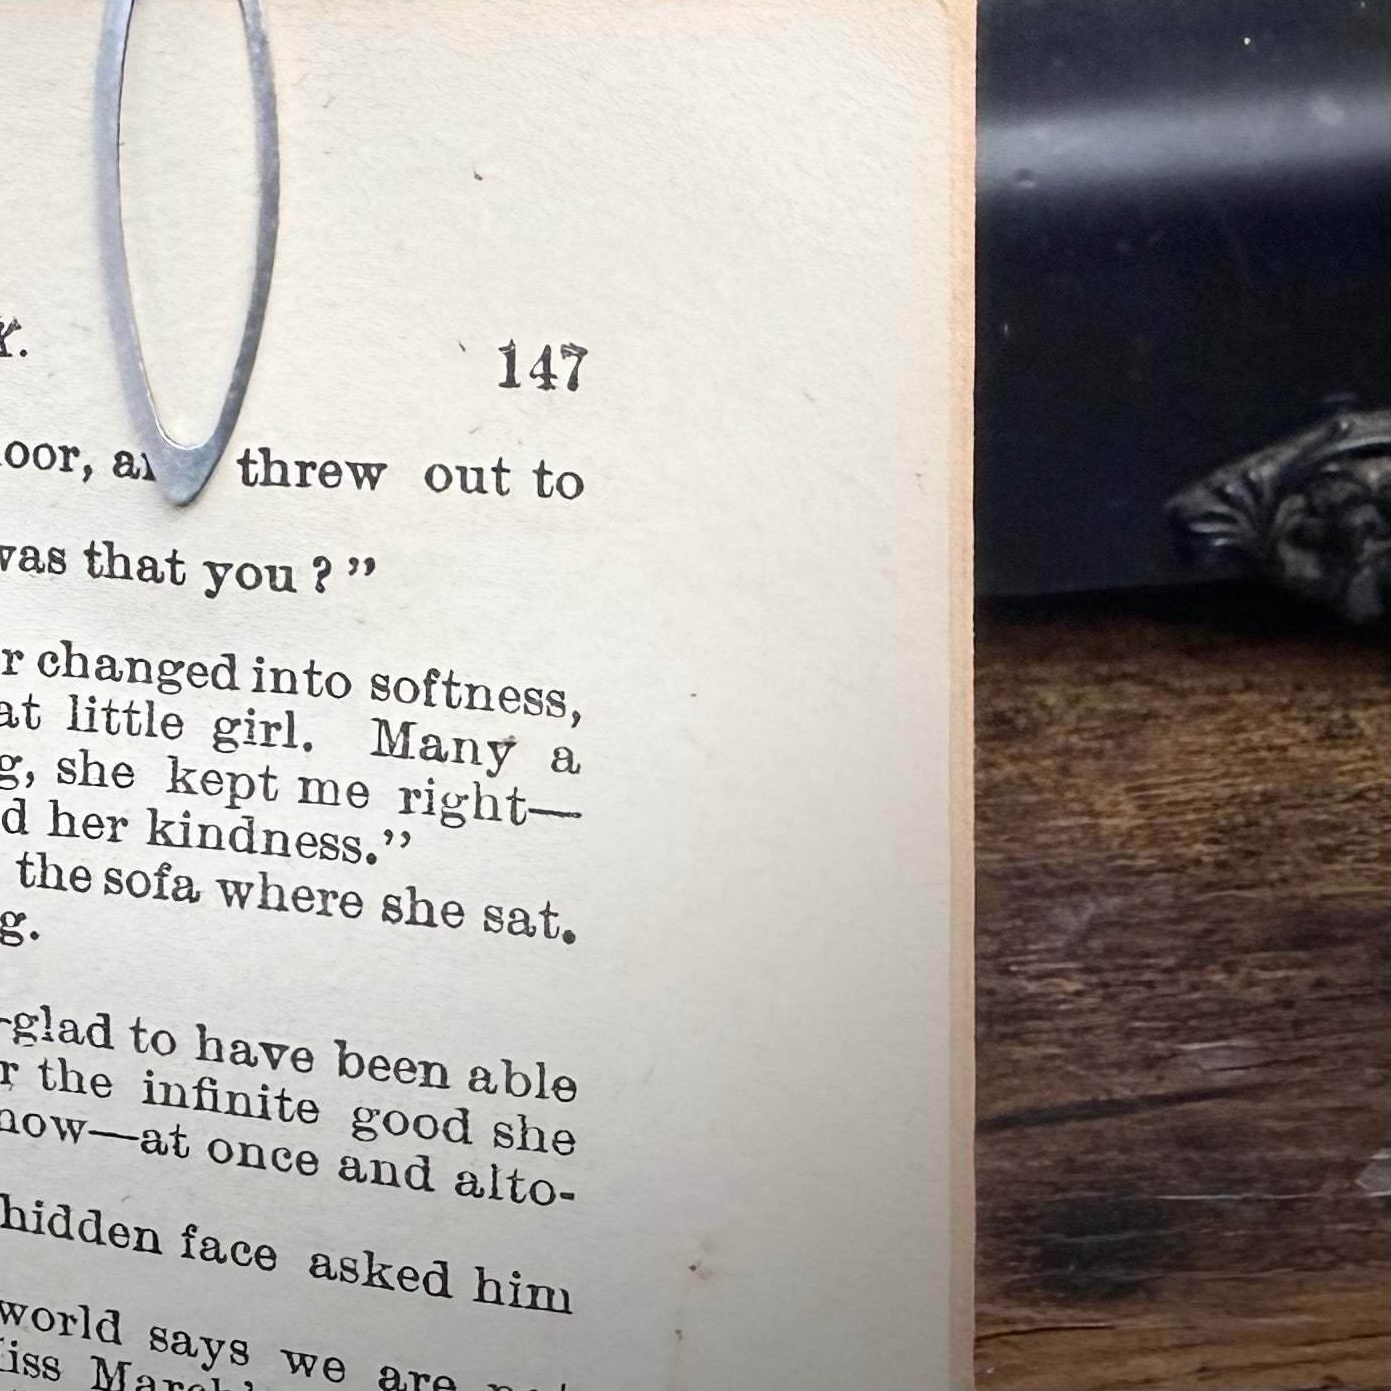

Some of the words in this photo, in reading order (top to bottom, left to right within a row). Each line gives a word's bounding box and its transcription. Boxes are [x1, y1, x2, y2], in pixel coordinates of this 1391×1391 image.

[497, 339, 589, 392] 147
[237, 446, 388, 491] threw
[424, 457, 511, 496] out
[532, 460, 584, 500] to
[83, 540, 186, 586] that
[37, 640, 240, 695] changed
[251, 656, 352, 699] into
[371, 668, 581, 728] softness,
[66, 694, 184, 740] little
[212, 708, 312, 753] girl.
[370, 718, 517, 778] Many
[551, 747, 581, 774] a
[57, 748, 134, 789] she
[166, 755, 278, 810] kept
[298, 777, 369, 809] me
[47, 799, 128, 843] her
[146, 808, 411, 865] kindness.”
[38, 1057, 113, 1098] the
[142, 1069, 320, 1124] infinite
[352, 1107, 473, 1145] good
[494, 1114, 576, 1156] she
[181, 1223, 277, 1271] face
[309, 1250, 453, 1298] asked
[473, 1266, 573, 1315] him
